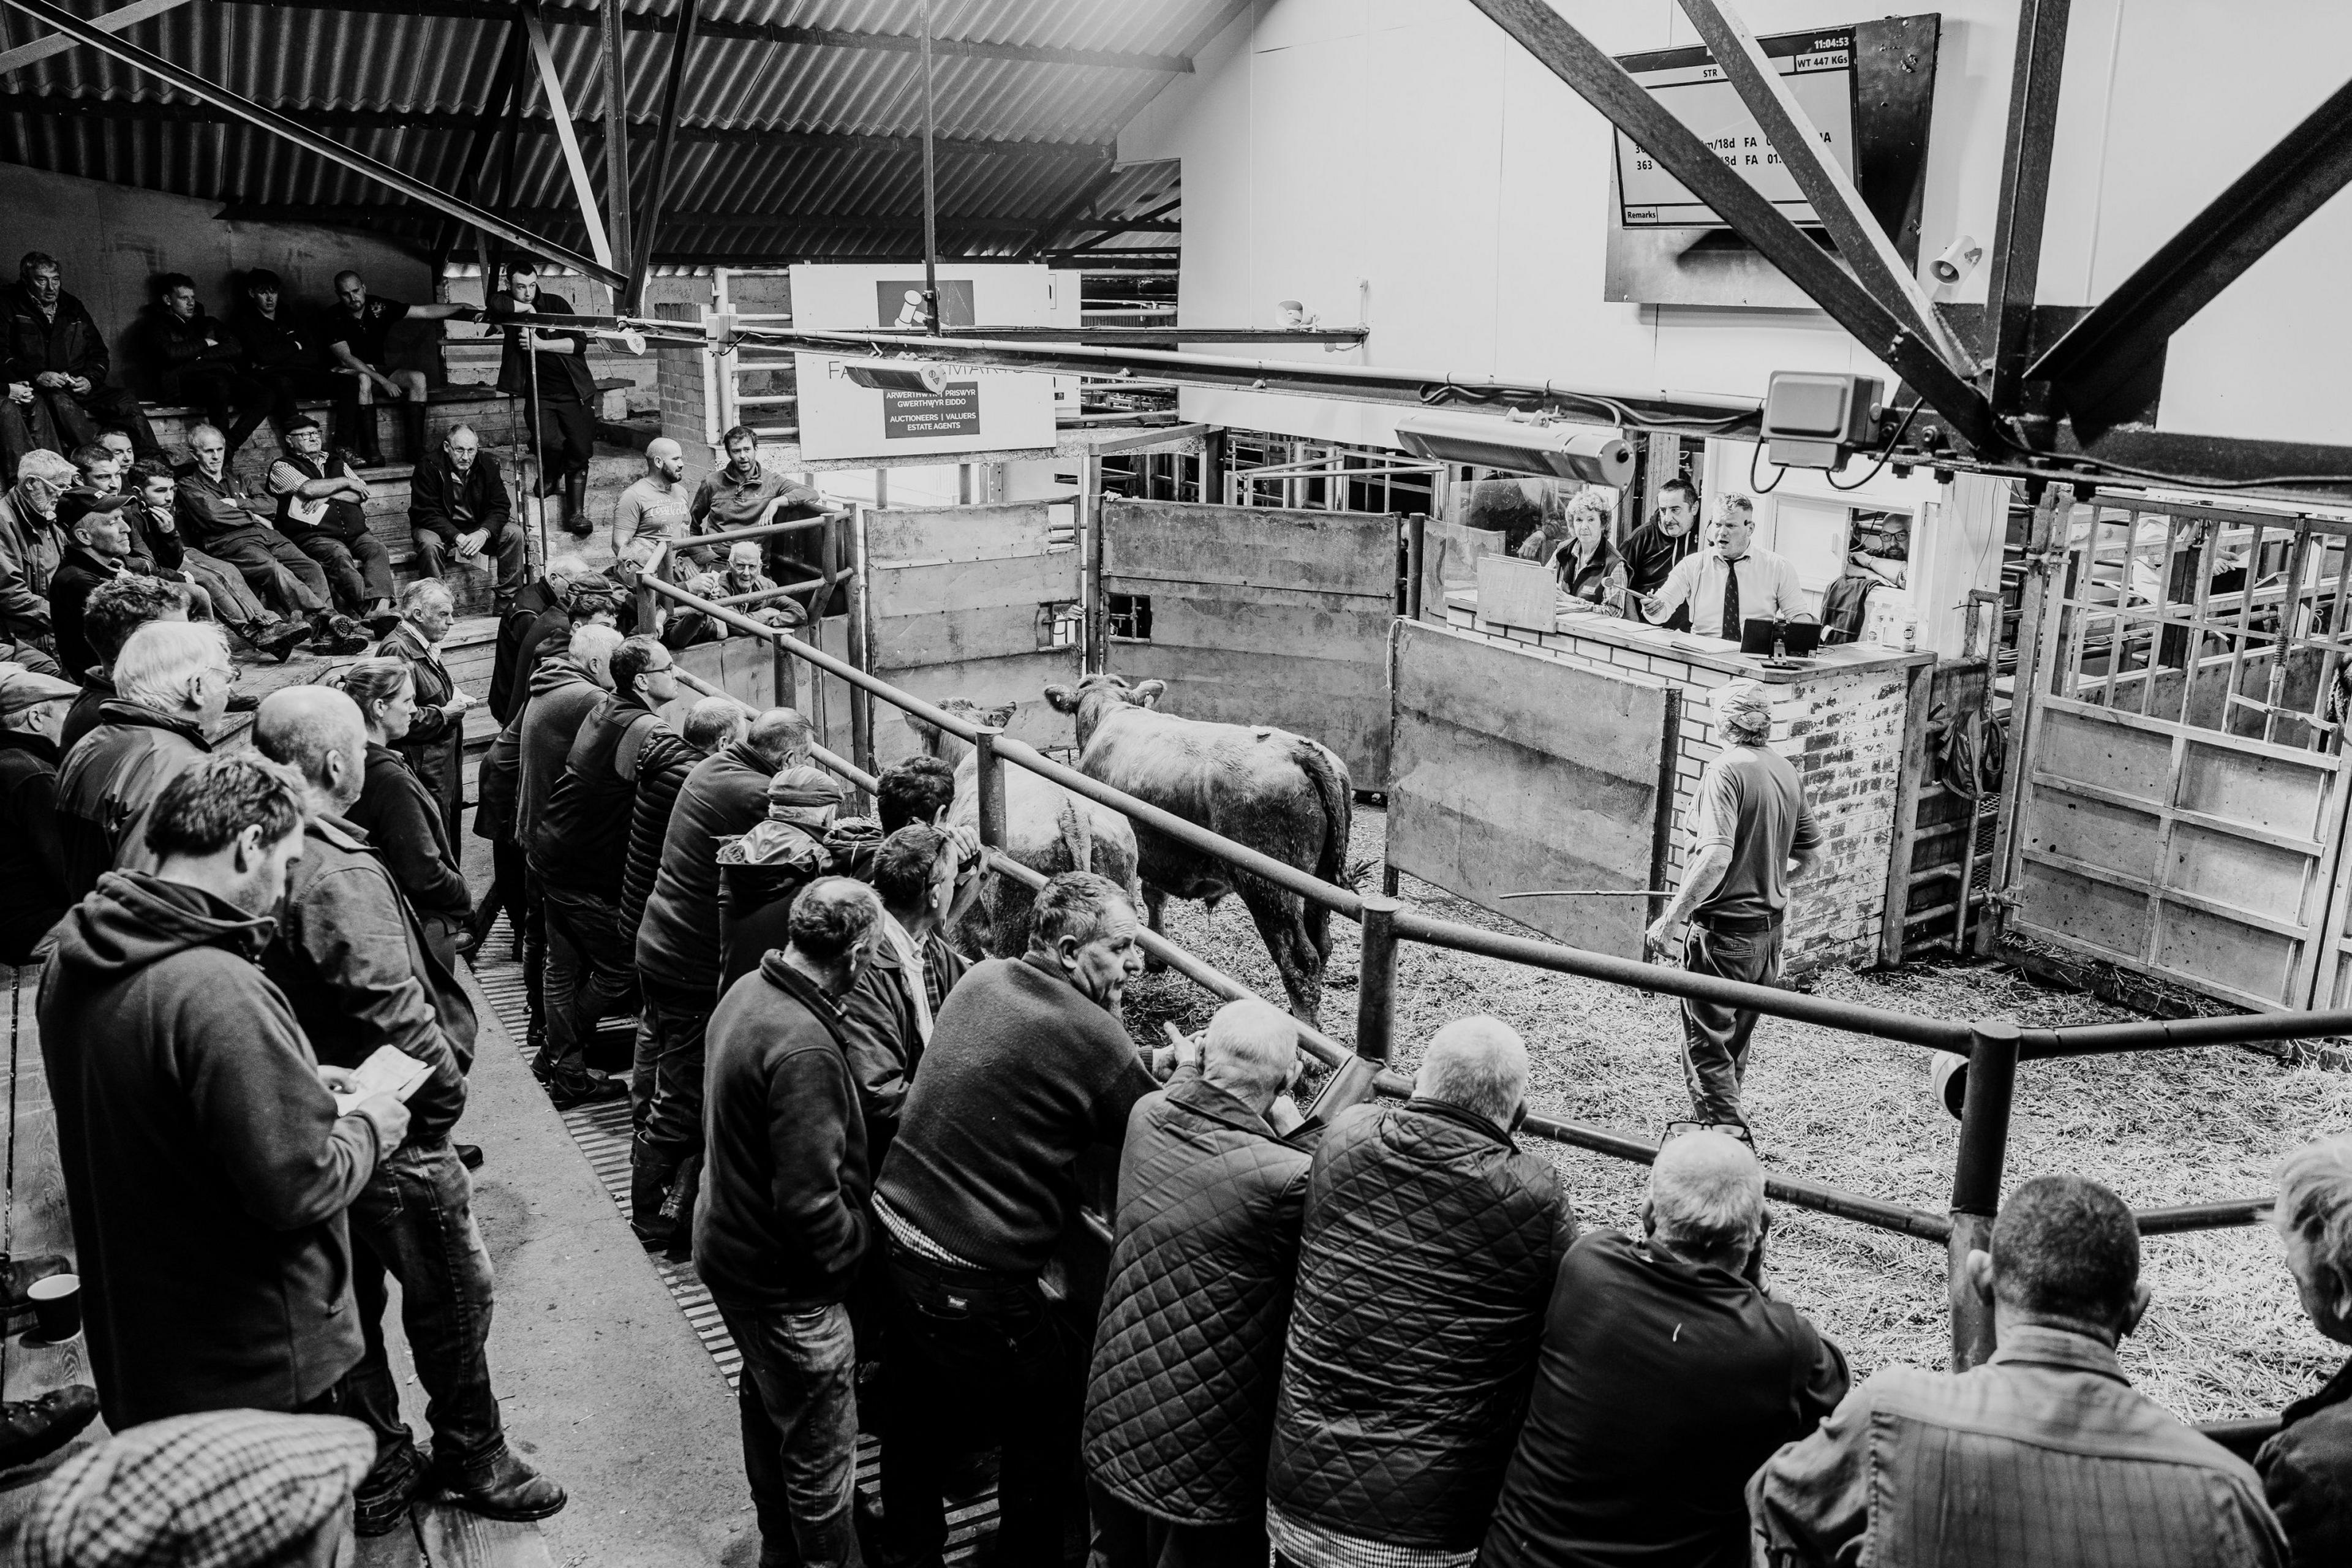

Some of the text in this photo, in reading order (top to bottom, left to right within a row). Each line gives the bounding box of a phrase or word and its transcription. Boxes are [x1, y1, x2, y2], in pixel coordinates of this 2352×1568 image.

[1814, 37, 1849, 49] 11:04:53
[1797, 55, 1848, 68] WT 447 KGs
[1703, 69, 1717, 78] STR
[1744, 137, 1757, 147] FA
[1637, 160, 1653, 170] 363
[1745, 154, 1758, 165] FA
[1627, 211, 1656, 219] Remarks
[897, 399, 944, 407] GWERTHWYR
[889, 413, 939, 423] AUCTIONEERS
